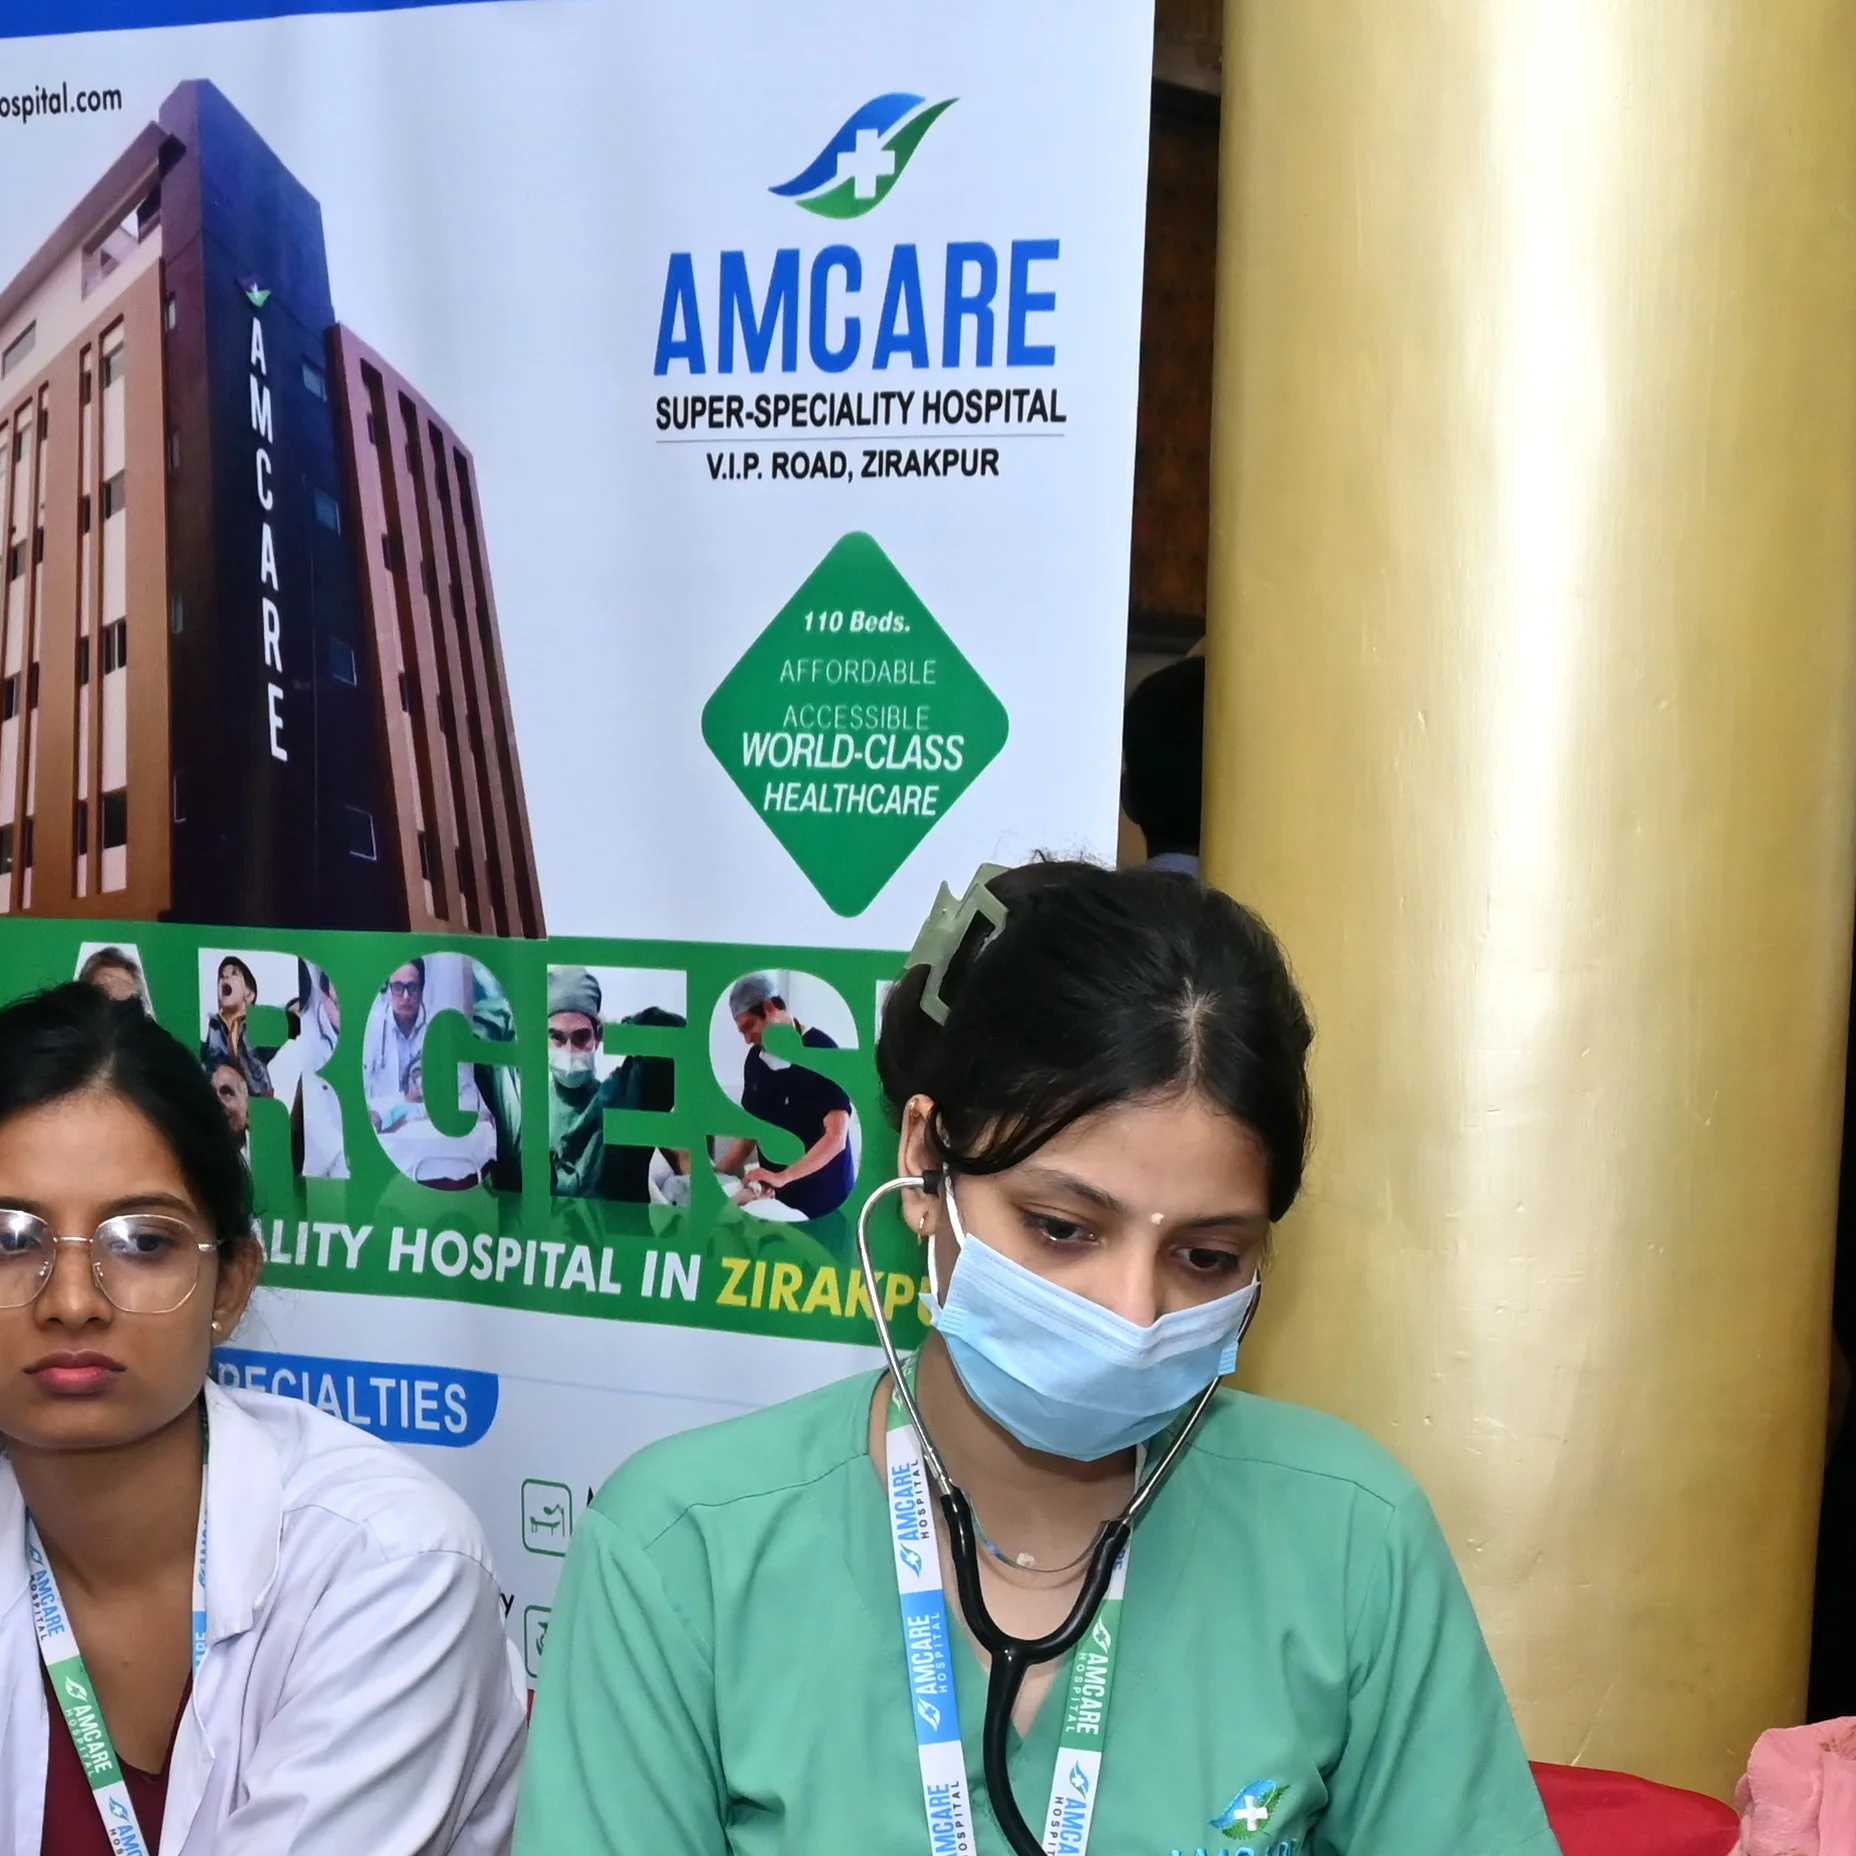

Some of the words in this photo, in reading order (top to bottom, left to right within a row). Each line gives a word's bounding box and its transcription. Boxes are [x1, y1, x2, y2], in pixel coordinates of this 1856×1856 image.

[654, 238, 1060, 376] AMCARE
[656, 390, 915, 430] SUPER-SPECIALITY
[922, 388, 1067, 426] HOSPITAL
[706, 451, 762, 480] V.I.P.
[772, 450, 853, 483] ROAD,
[861, 448, 1000, 478] ZIRAKPUR
[250, 317, 287, 762] AMCARE
[804, 610, 844, 633] 110
[850, 610, 911, 633] Beds.
[779, 658, 936, 685] AFFORDABLE
[742, 731, 965, 772] WORLD-CLASS
[783, 704, 930, 731] ACCESSIBLE
[763, 782, 940, 816] HEALTHCARE
[387, 1226, 621, 1294] HOSPITAL
[641, 1250, 701, 1302] IN
[716, 1256, 932, 1327] ZIRAKP
[218, 1362, 468, 1434] PECIALTIES
[892, 1461, 920, 1542] AMCARE
[911, 1458, 929, 1540] HOSPITAL
[29, 1573, 48, 1641] HOSPITAL
[35, 1569, 65, 1637] AMCARE
[907, 1613, 937, 1695] AMCARE
[930, 1612, 948, 1694] HOSPITAL
[1065, 1651, 1087, 1733] HOSPITAL
[1076, 1652, 1109, 1736] AMCARE
[64, 1707, 95, 1779] HOSPITAL
[72, 1704, 113, 1775] AMCARE
[1047, 1796, 1065, 1856] HOSPIT
